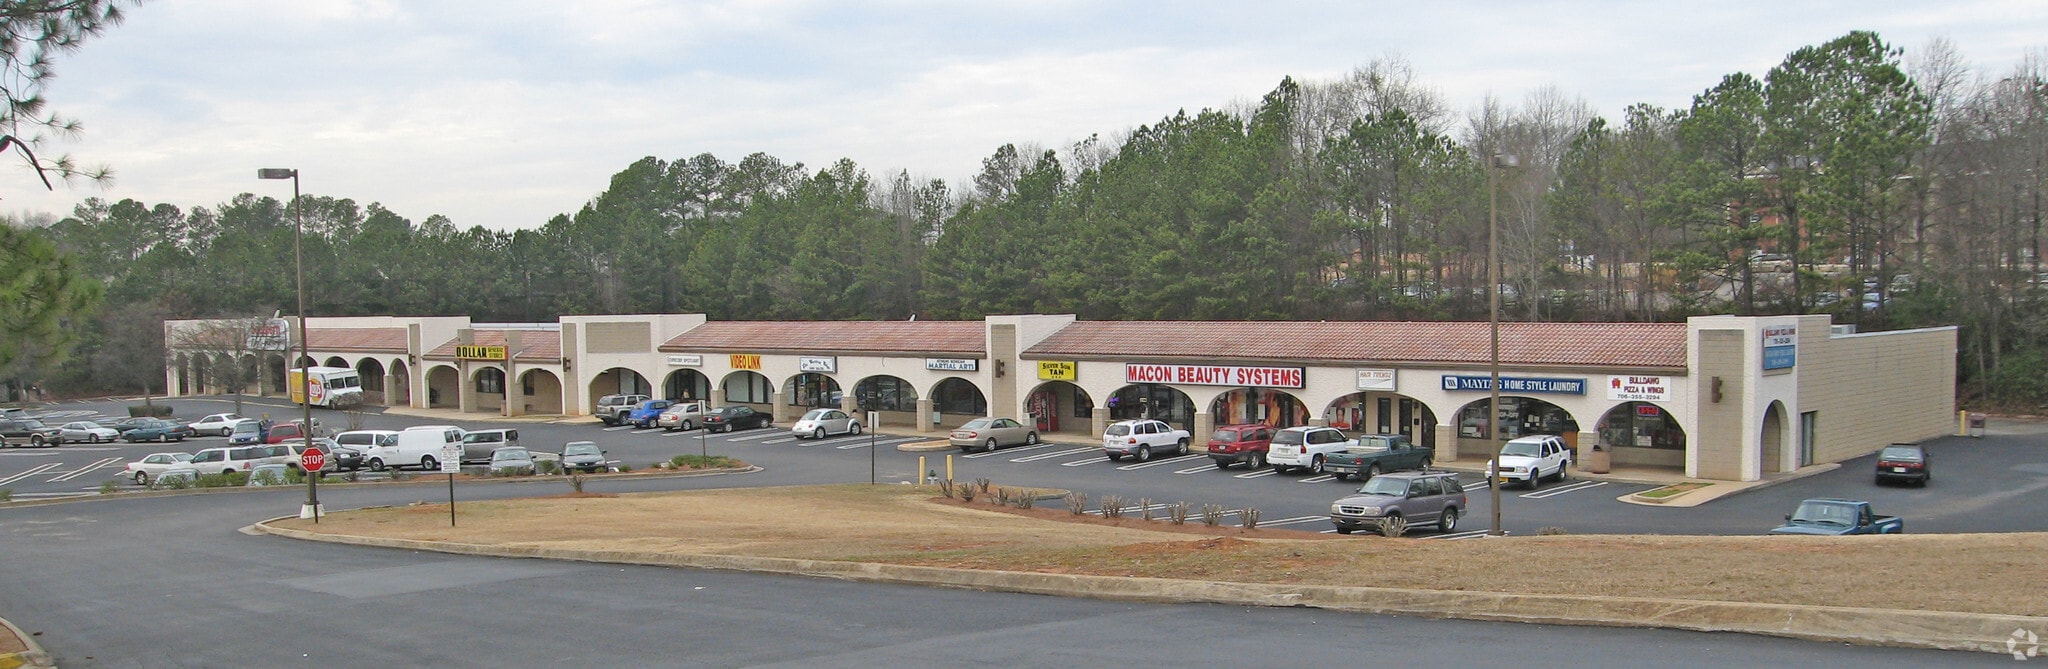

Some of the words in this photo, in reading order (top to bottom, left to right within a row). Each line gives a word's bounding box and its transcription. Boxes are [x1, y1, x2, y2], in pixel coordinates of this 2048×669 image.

[456, 346, 487, 358] DOLLAR
[730, 354, 747, 369] VIDEO
[748, 355, 761, 369] LINK
[1128, 365, 1172, 382] MACON
[1178, 366, 1231, 383] BEAUTY
[1237, 367, 1301, 387] SYSTEMS
[1504, 380, 1525, 390] HOME
[1526, 381, 1547, 391] STYLE
[1548, 381, 1581, 392] LAUNDRY
[302, 455, 323, 466] STOP
